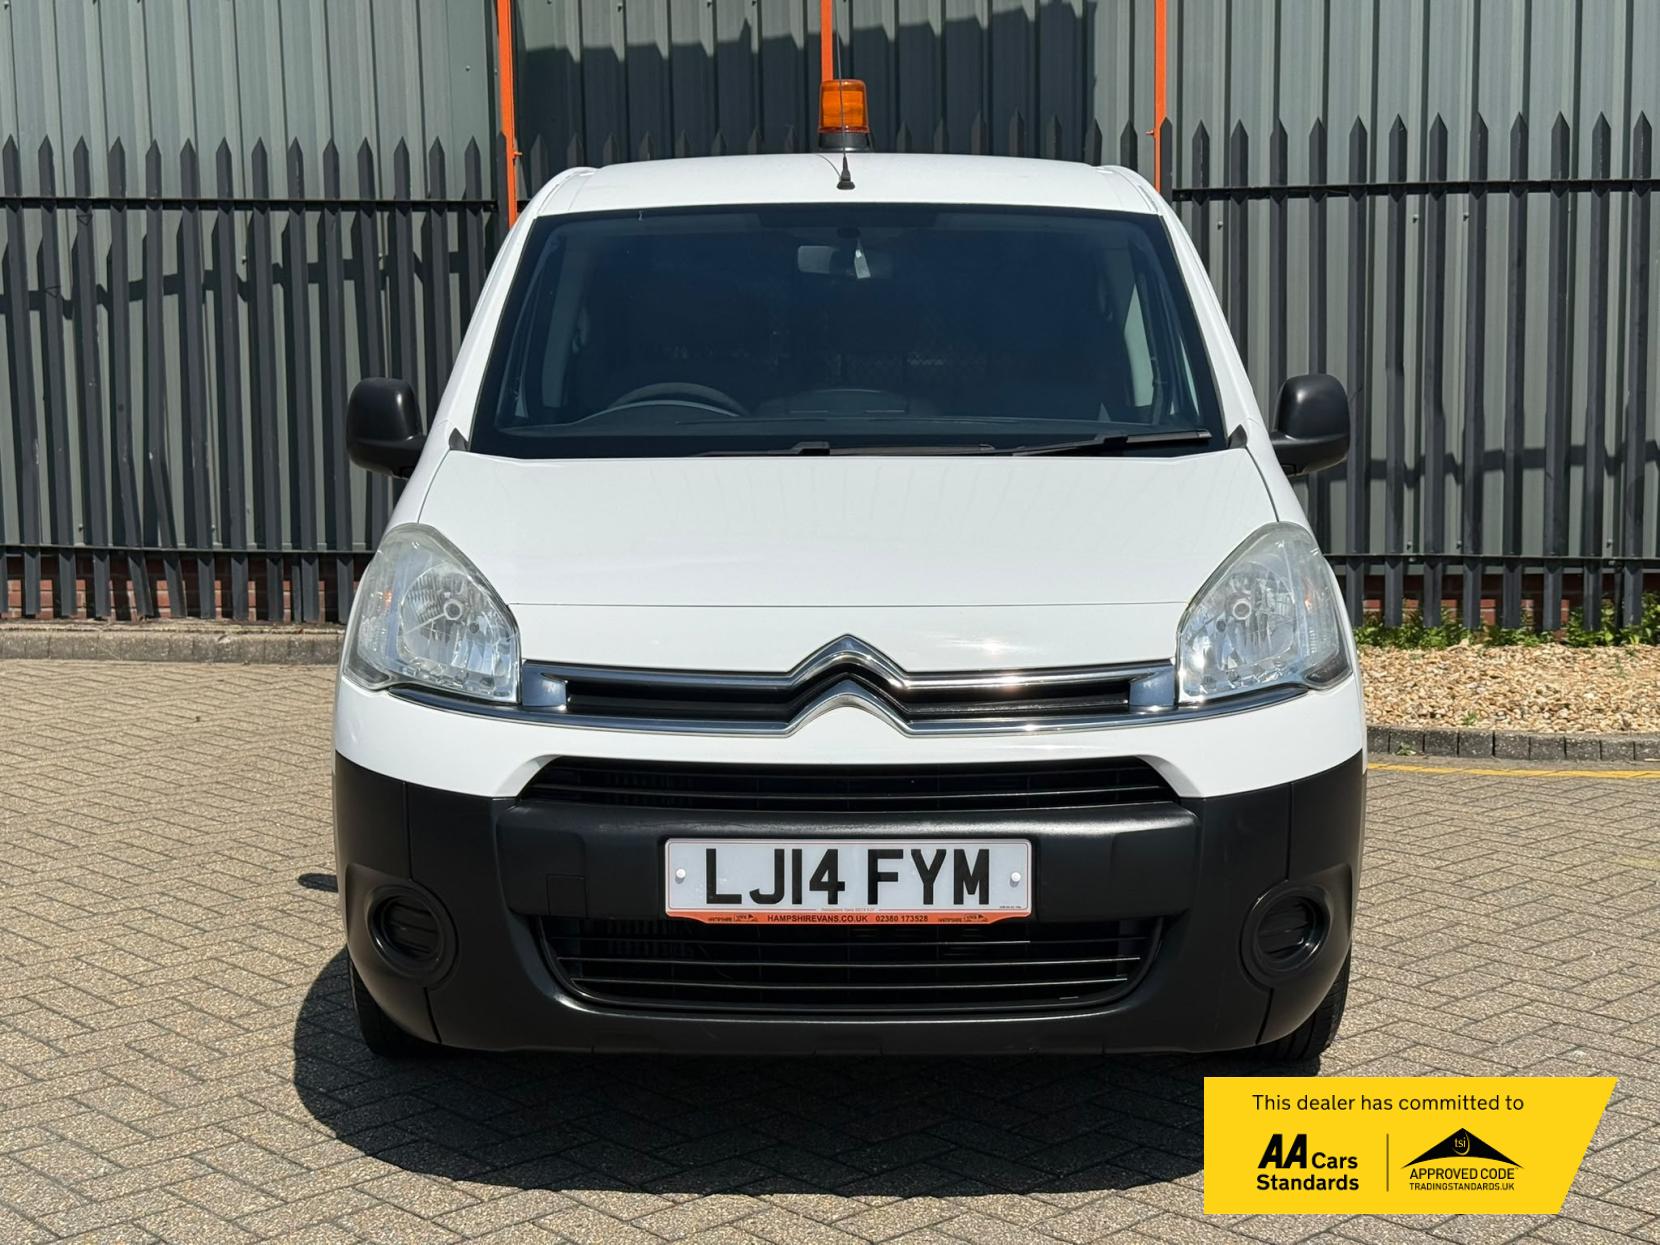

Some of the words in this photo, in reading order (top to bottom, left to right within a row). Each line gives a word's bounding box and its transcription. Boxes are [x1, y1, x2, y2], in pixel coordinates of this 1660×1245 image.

[705, 848, 846, 905] LJ14
[867, 848, 990, 905] FYM
[767, 914, 868, 923] HAMPSHIREVANS.CO.UK
[875, 914, 899, 923] 02380
[901, 914, 929, 923] 173528
